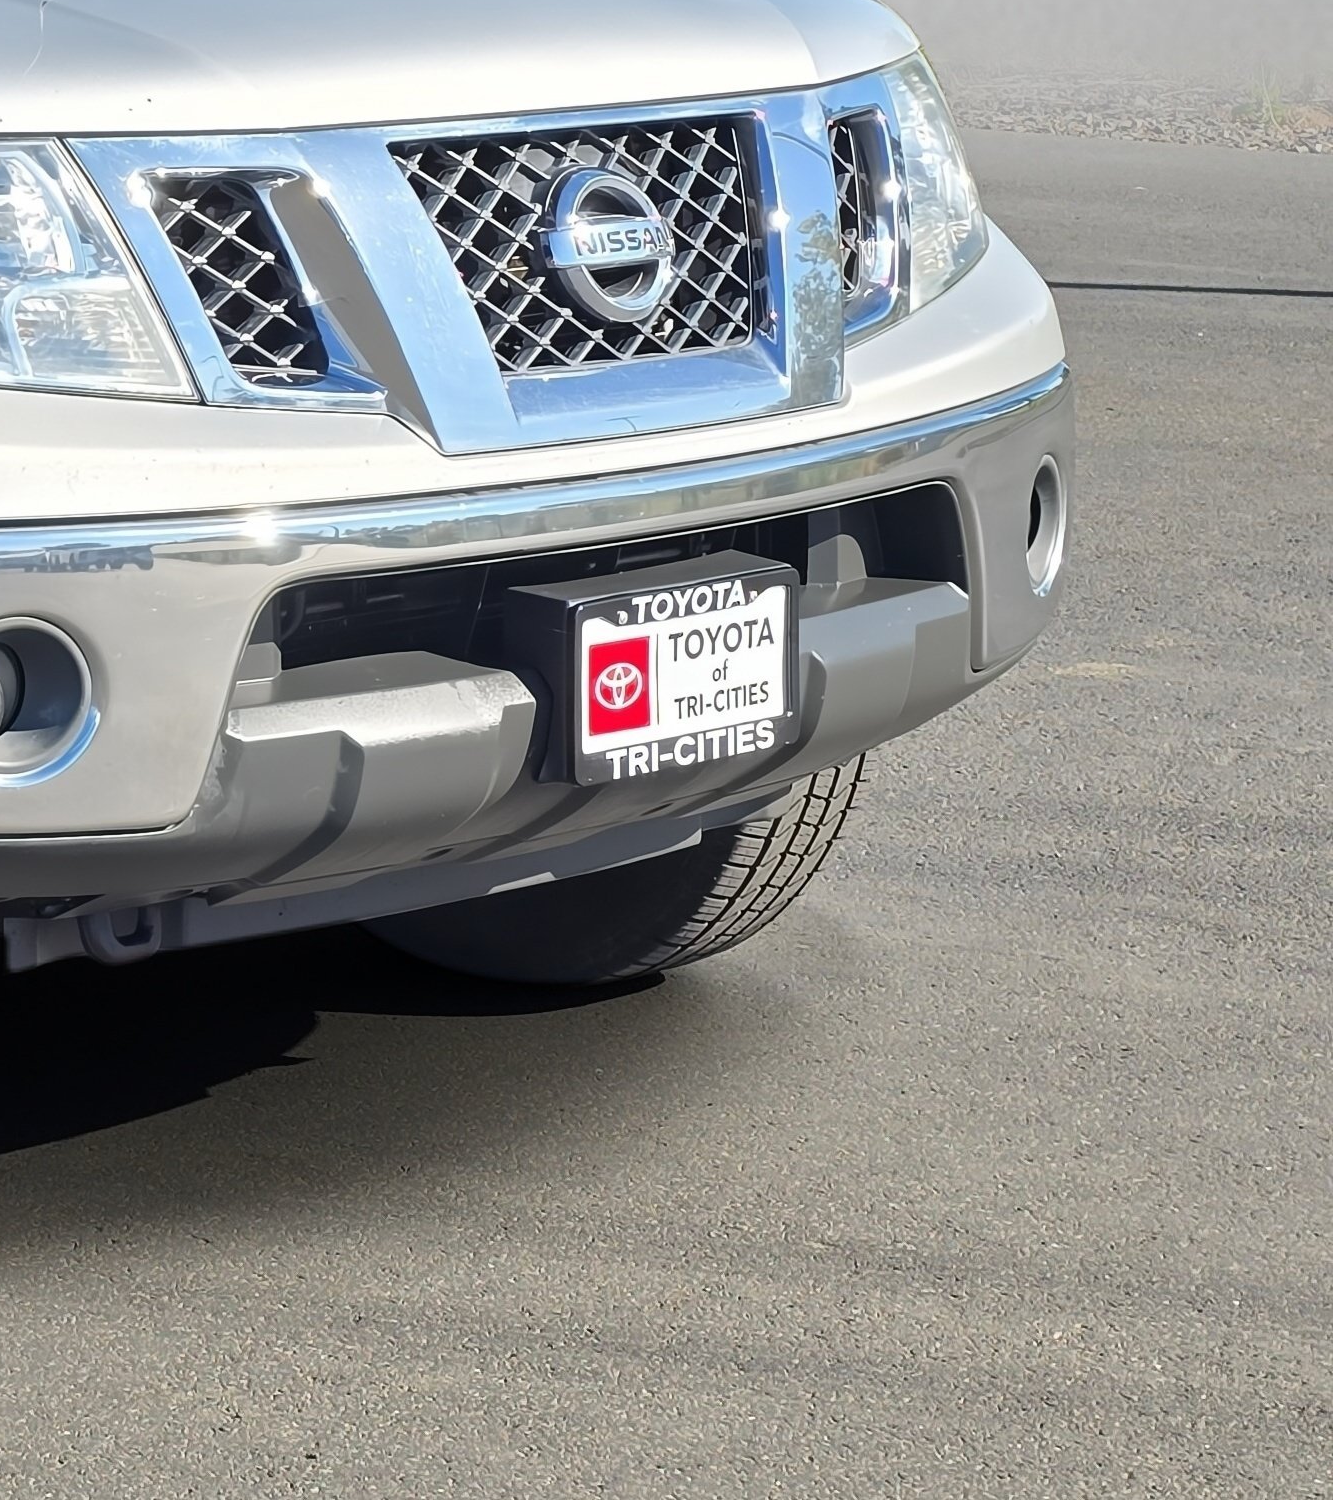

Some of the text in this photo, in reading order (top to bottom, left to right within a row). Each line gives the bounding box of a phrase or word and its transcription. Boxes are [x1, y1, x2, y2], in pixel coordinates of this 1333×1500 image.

[574, 226, 674, 256] NISSAN
[632, 580, 746, 624] TOYOTA
[669, 617, 774, 662] TOYOTA
[712, 658, 729, 682] of
[674, 681, 769, 720] TRI-CITIES
[605, 719, 775, 780] TRI-CITIES
